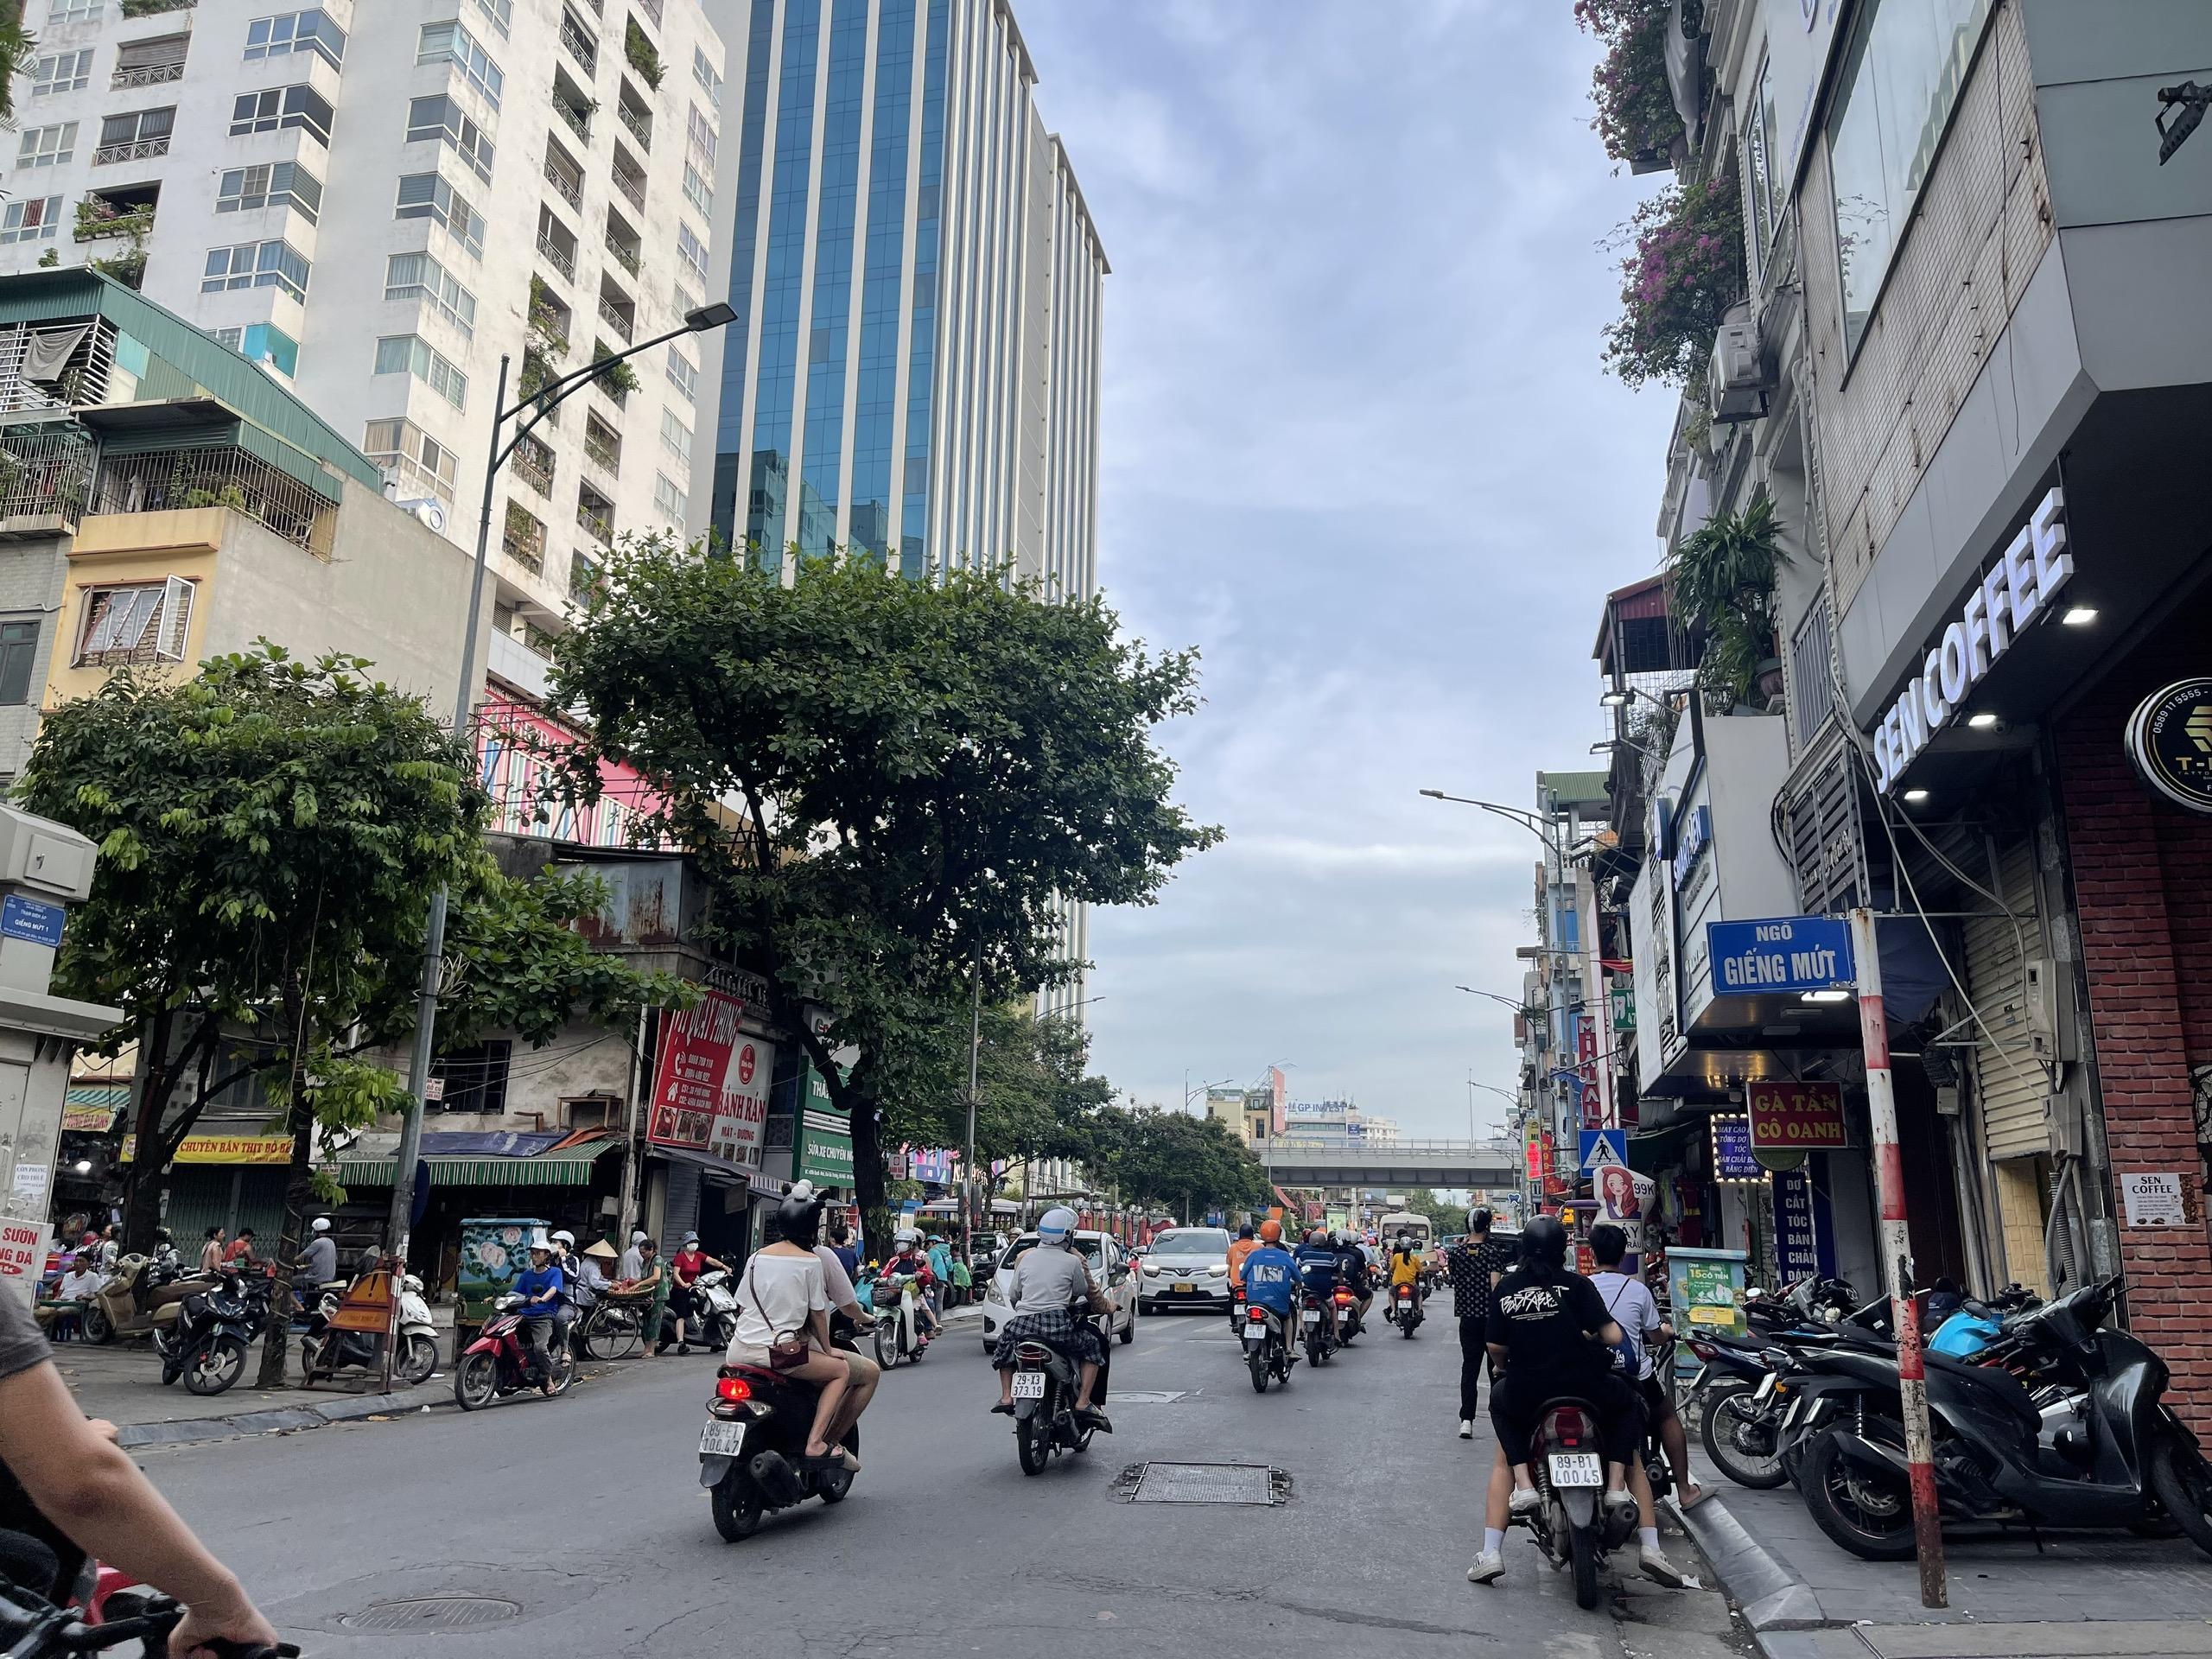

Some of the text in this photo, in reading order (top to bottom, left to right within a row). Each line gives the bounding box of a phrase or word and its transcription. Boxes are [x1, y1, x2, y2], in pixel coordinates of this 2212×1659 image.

[1923, 486, 2074, 728] COFFEE
[2152, 689, 2202, 734] 0589 11 5555
[1755, 922, 1793, 942] NGÕ
[1724, 947, 1786, 985] GIẾNG
[1790, 944, 1836, 980] MỨT
[717, 1084, 766, 1124] BÁNH RÁN
[1298, 1103, 1311, 1112] GP
[1755, 1087, 1838, 1113] GÀ TẦN
[1757, 1118, 1842, 1140] CÔ OANH
[180, 1139, 217, 1153] CHUYÊN
[219, 1139, 239, 1153] BÁN
[241, 1142, 264, 1156] THỊT
[264, 1140, 277, 1154] BÒ
[827, 1146, 847, 1161] CHUYÊN
[1734, 1144, 1746, 1153] TÓC
[1634, 1183, 1654, 1195] 99K
[1787, 1179, 1802, 1191] ĐƠ
[1786, 1194, 1805, 1209] CẮT
[1787, 1213, 1808, 1227] TÓC
[1788, 1232, 1810, 1245] BÀN
[16, 1249, 33, 1265] ĐÁ
[1788, 1249, 1814, 1264] CHẢI
[1690, 1269, 1702, 1278] 15
[1017, 1375, 1040, 1386] 29-X3
[1013, 1385, 1043, 1396] 373.19
[702, 1436, 740, 1454] 100.47
[1557, 1455, 1592, 1469] 89-B1
[1554, 1470, 1600, 1484] 400.45
